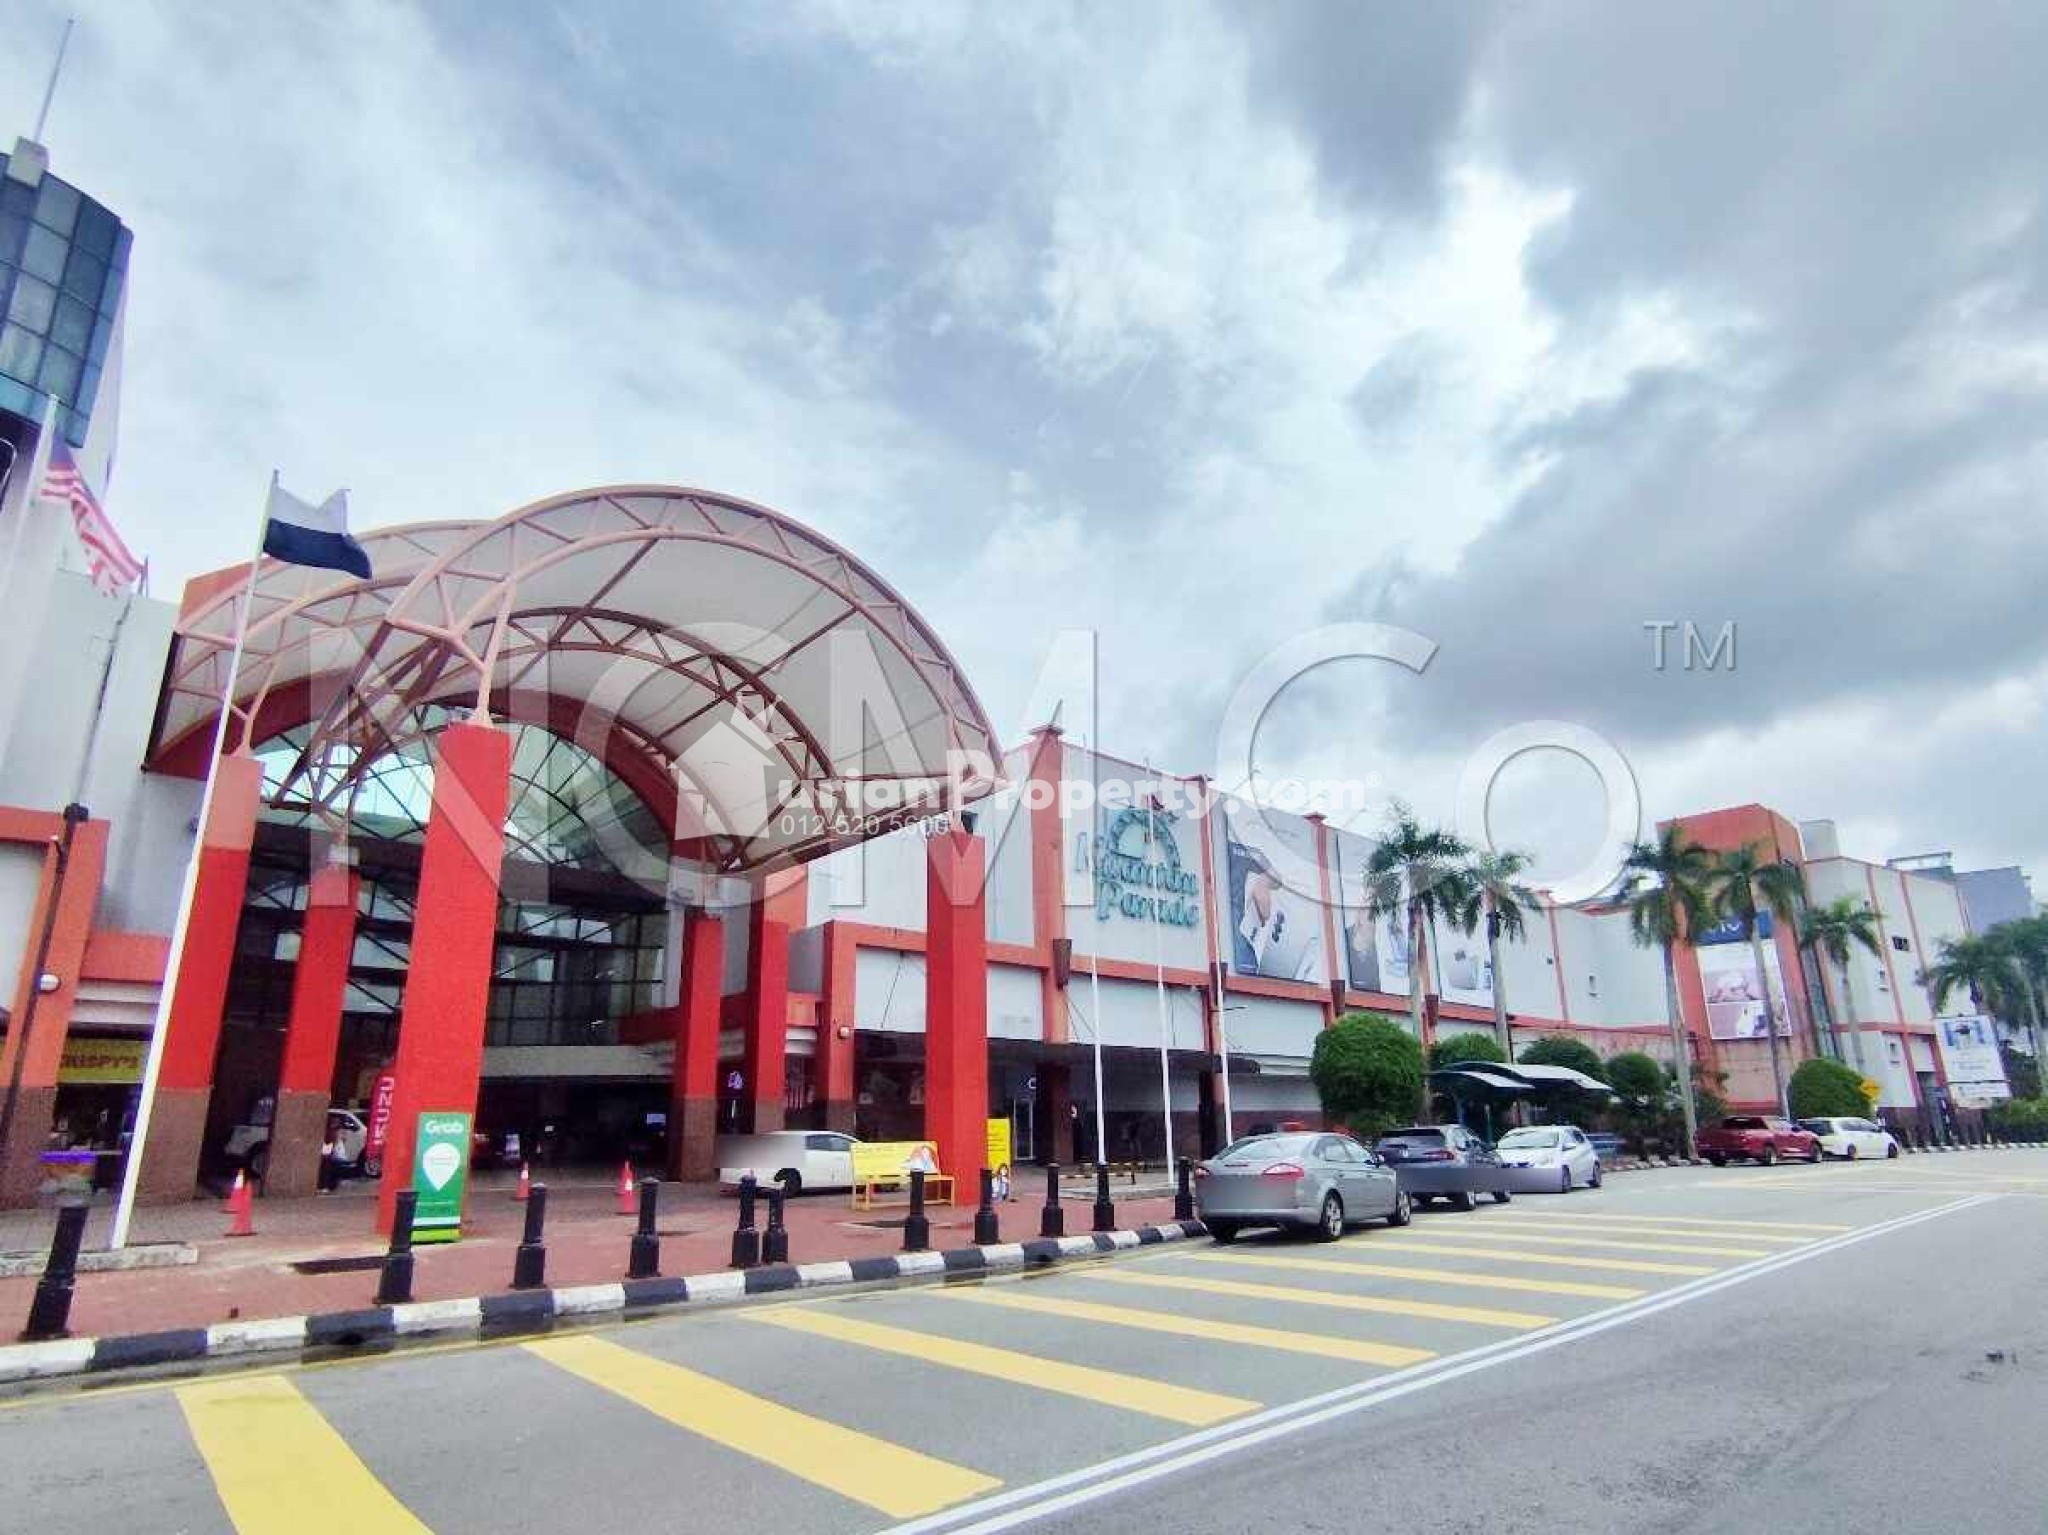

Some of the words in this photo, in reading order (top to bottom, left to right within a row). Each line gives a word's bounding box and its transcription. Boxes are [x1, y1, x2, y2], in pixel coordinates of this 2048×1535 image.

[1096, 877, 1200, 929] Parade
[371, 1076, 396, 1146] ISUZU
[425, 1119, 464, 1135] Grab
